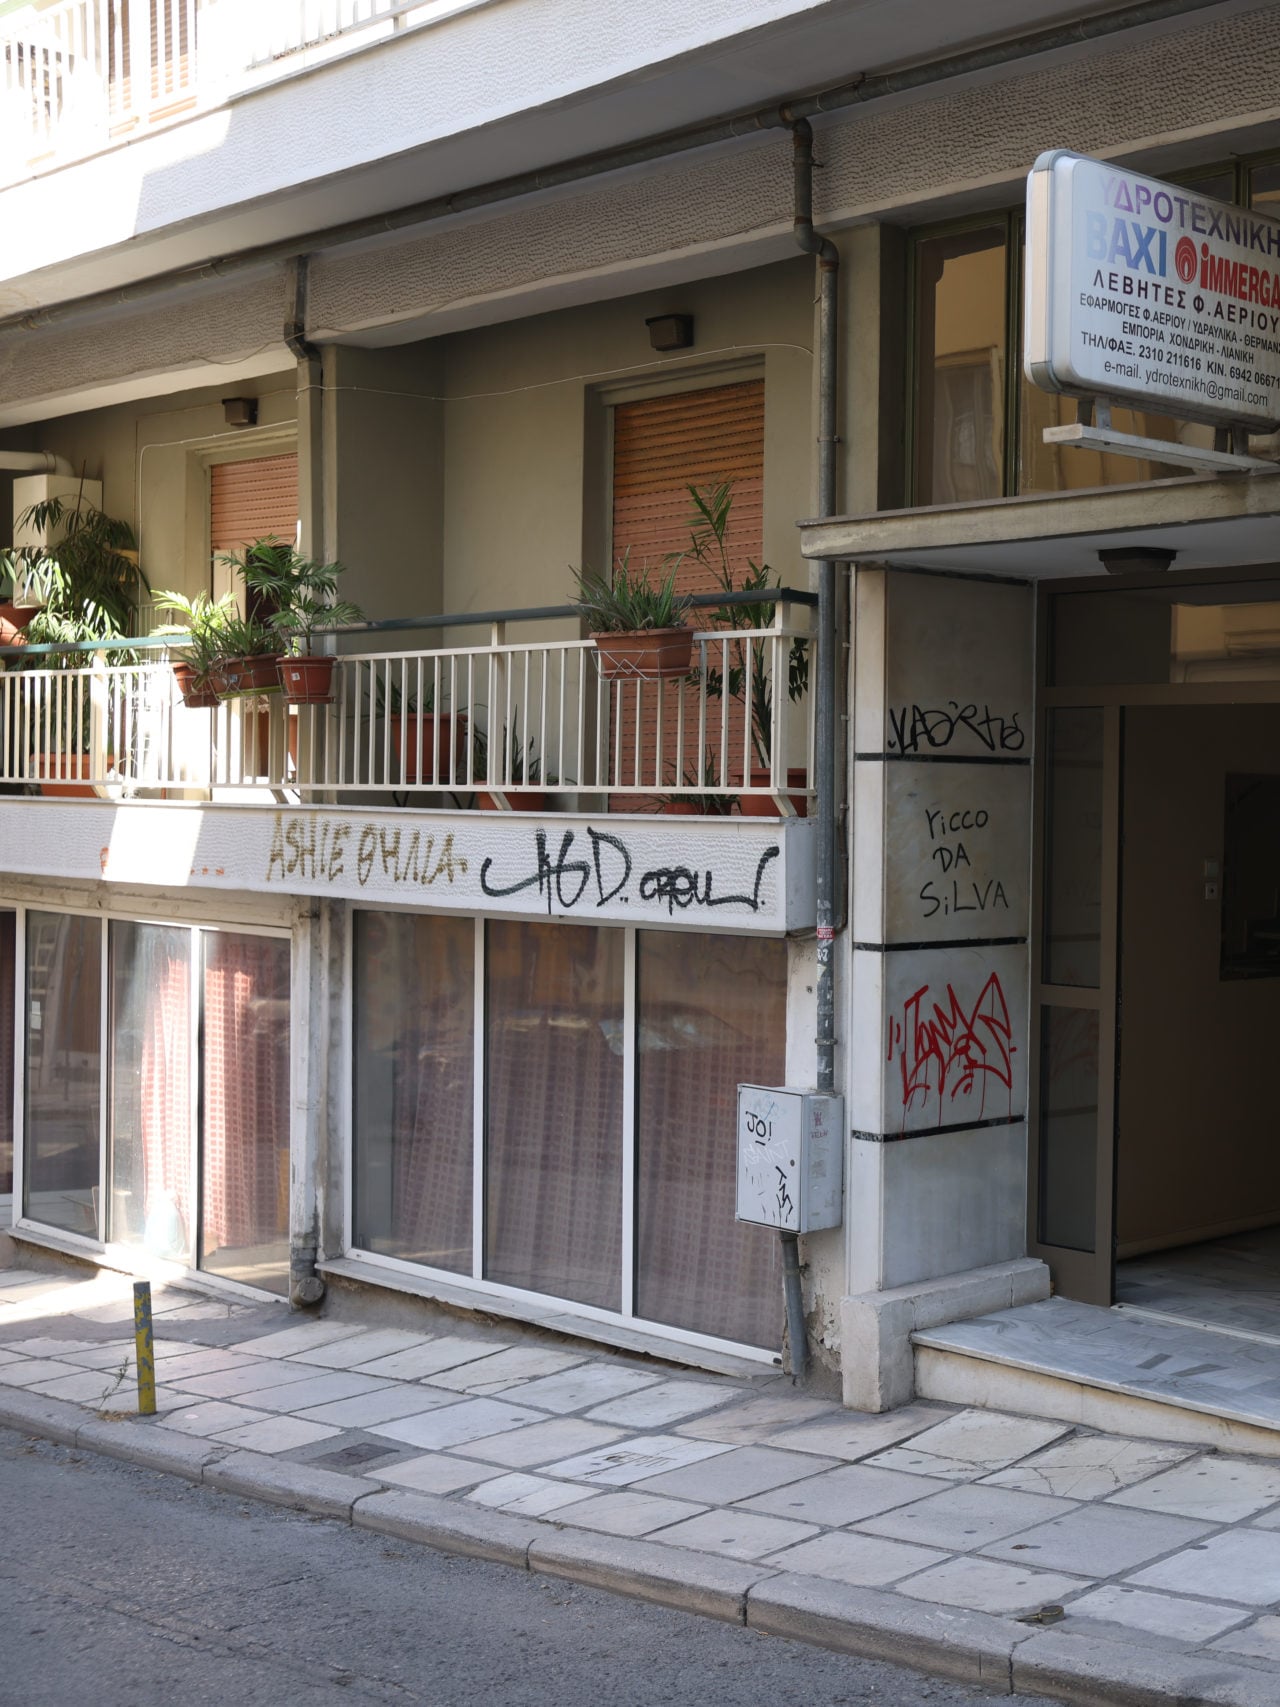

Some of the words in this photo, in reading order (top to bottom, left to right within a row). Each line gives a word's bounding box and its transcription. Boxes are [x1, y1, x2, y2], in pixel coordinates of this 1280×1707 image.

[1085, 209, 1168, 278] BAXI
[1093, 269, 1187, 310] ΛΕΒΗΤΕΣ
[1079, 292, 1141, 319] ΕΦΑΡΜΟΓΕΣ
[1192, 320, 1238, 344] ΥΔΡΑΥΛΙΚΑ
[1122, 321, 1165, 343] ΕΜΠΟΡΙΑ
[1168, 332, 1215, 355] ΧΟΝΔΡΙΚΗ
[1220, 345, 1255, 365] ΛΙΑΝΙΚΗ
[1138, 344, 1164, 362] 2310
[1166, 351, 1202, 372] 211616
[1229, 366, 1253, 383] 6942
[1145, 368, 1269, 408] ydrotexnikh@gmail.com
